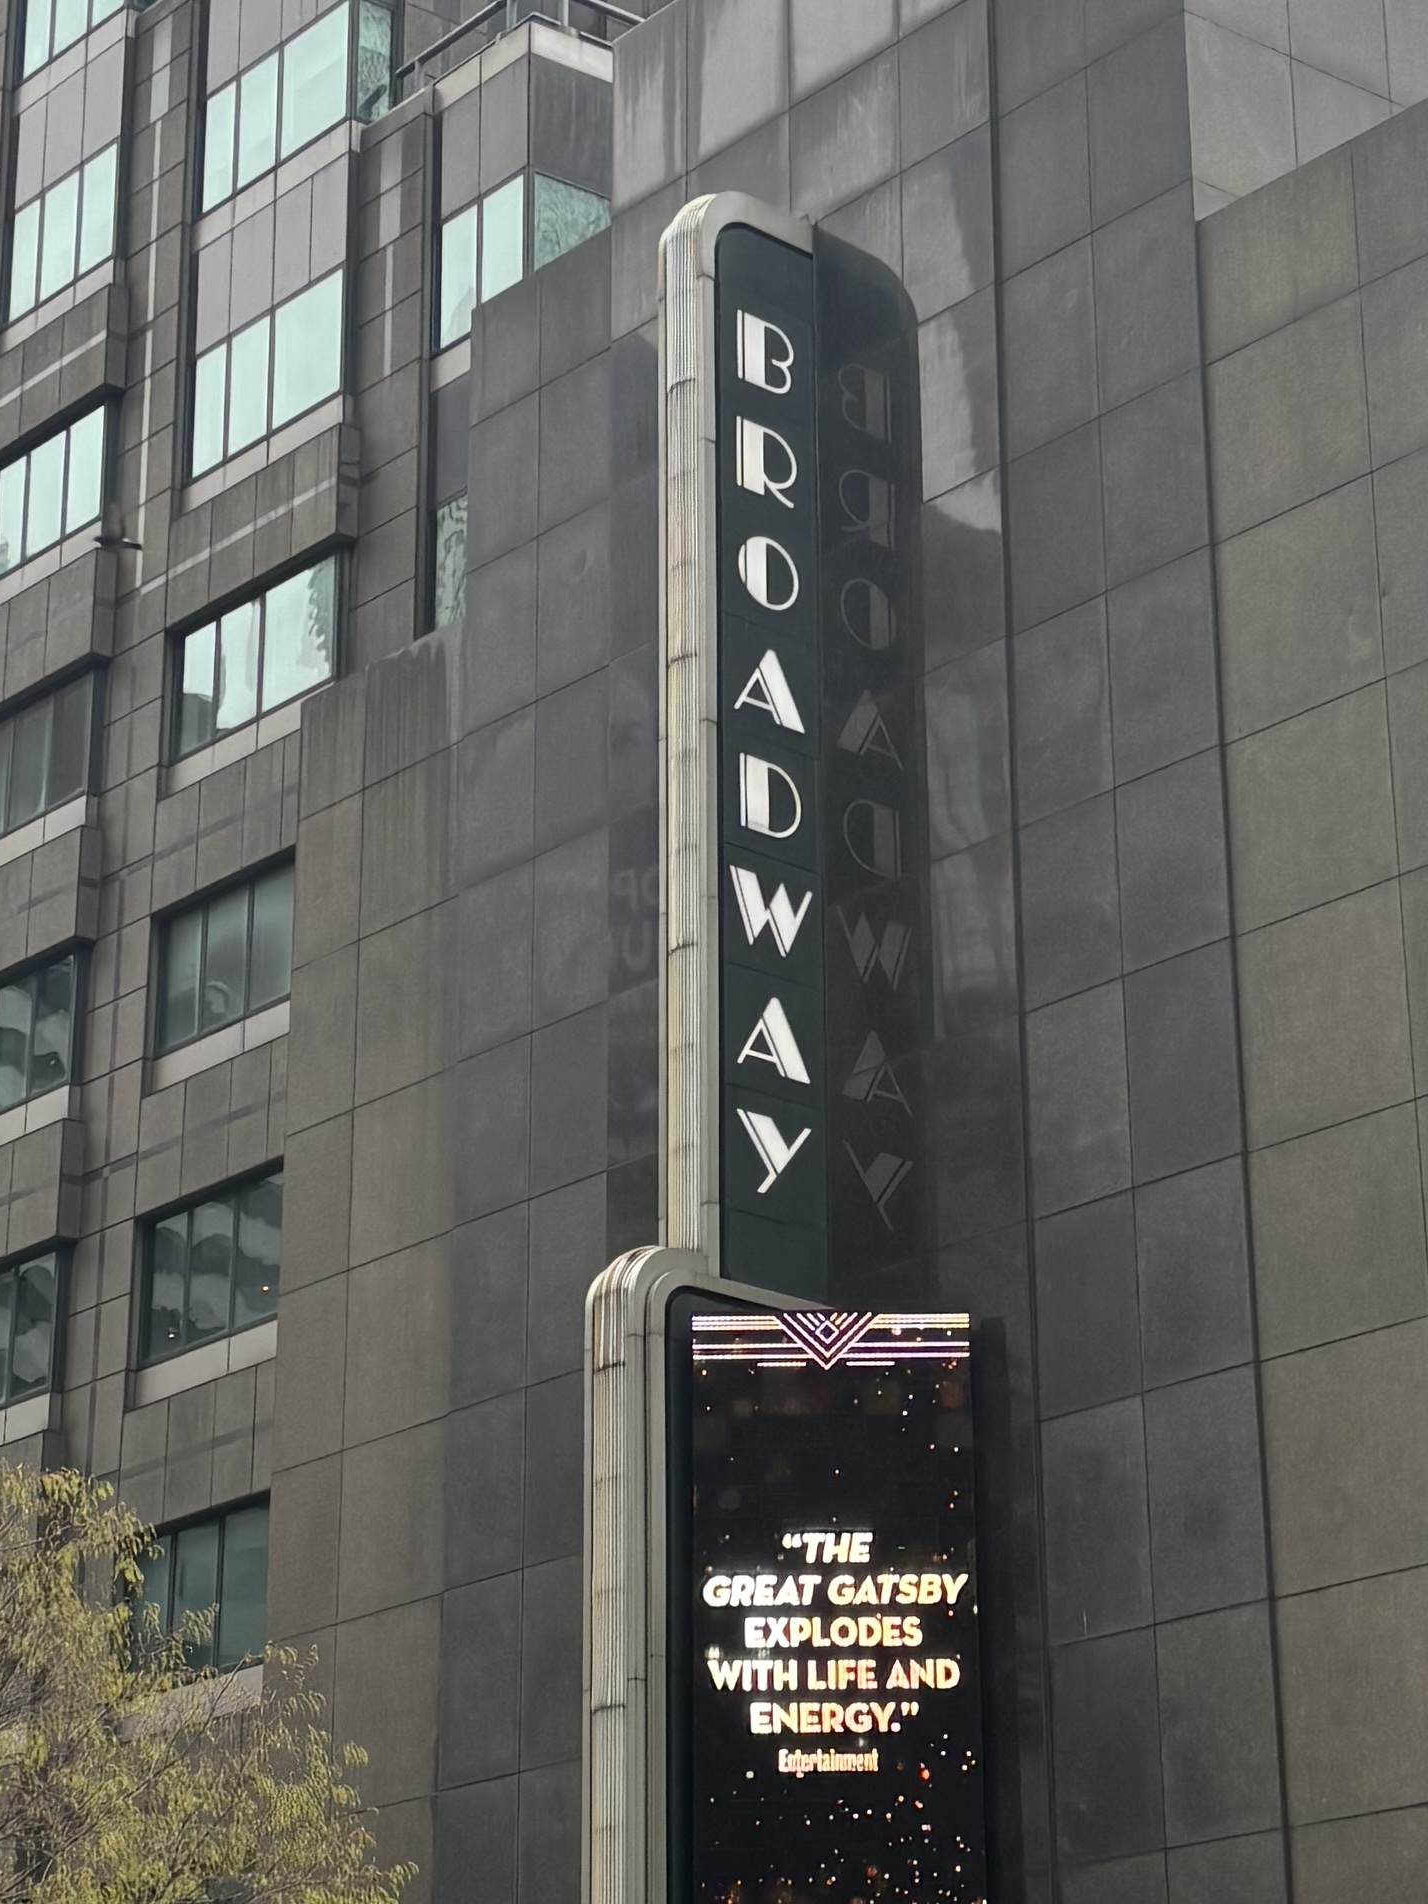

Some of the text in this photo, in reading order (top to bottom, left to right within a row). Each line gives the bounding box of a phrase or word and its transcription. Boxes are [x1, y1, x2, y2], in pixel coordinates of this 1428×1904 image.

[729, 309, 813, 1194] BROADWAY
[703, 1573, 968, 1607] GREAT GATSBY
[744, 1616, 923, 1648] EXPLODES
[707, 1658, 961, 1691] WITH LIFE AND
[778, 1748, 879, 1774] Entertainment
